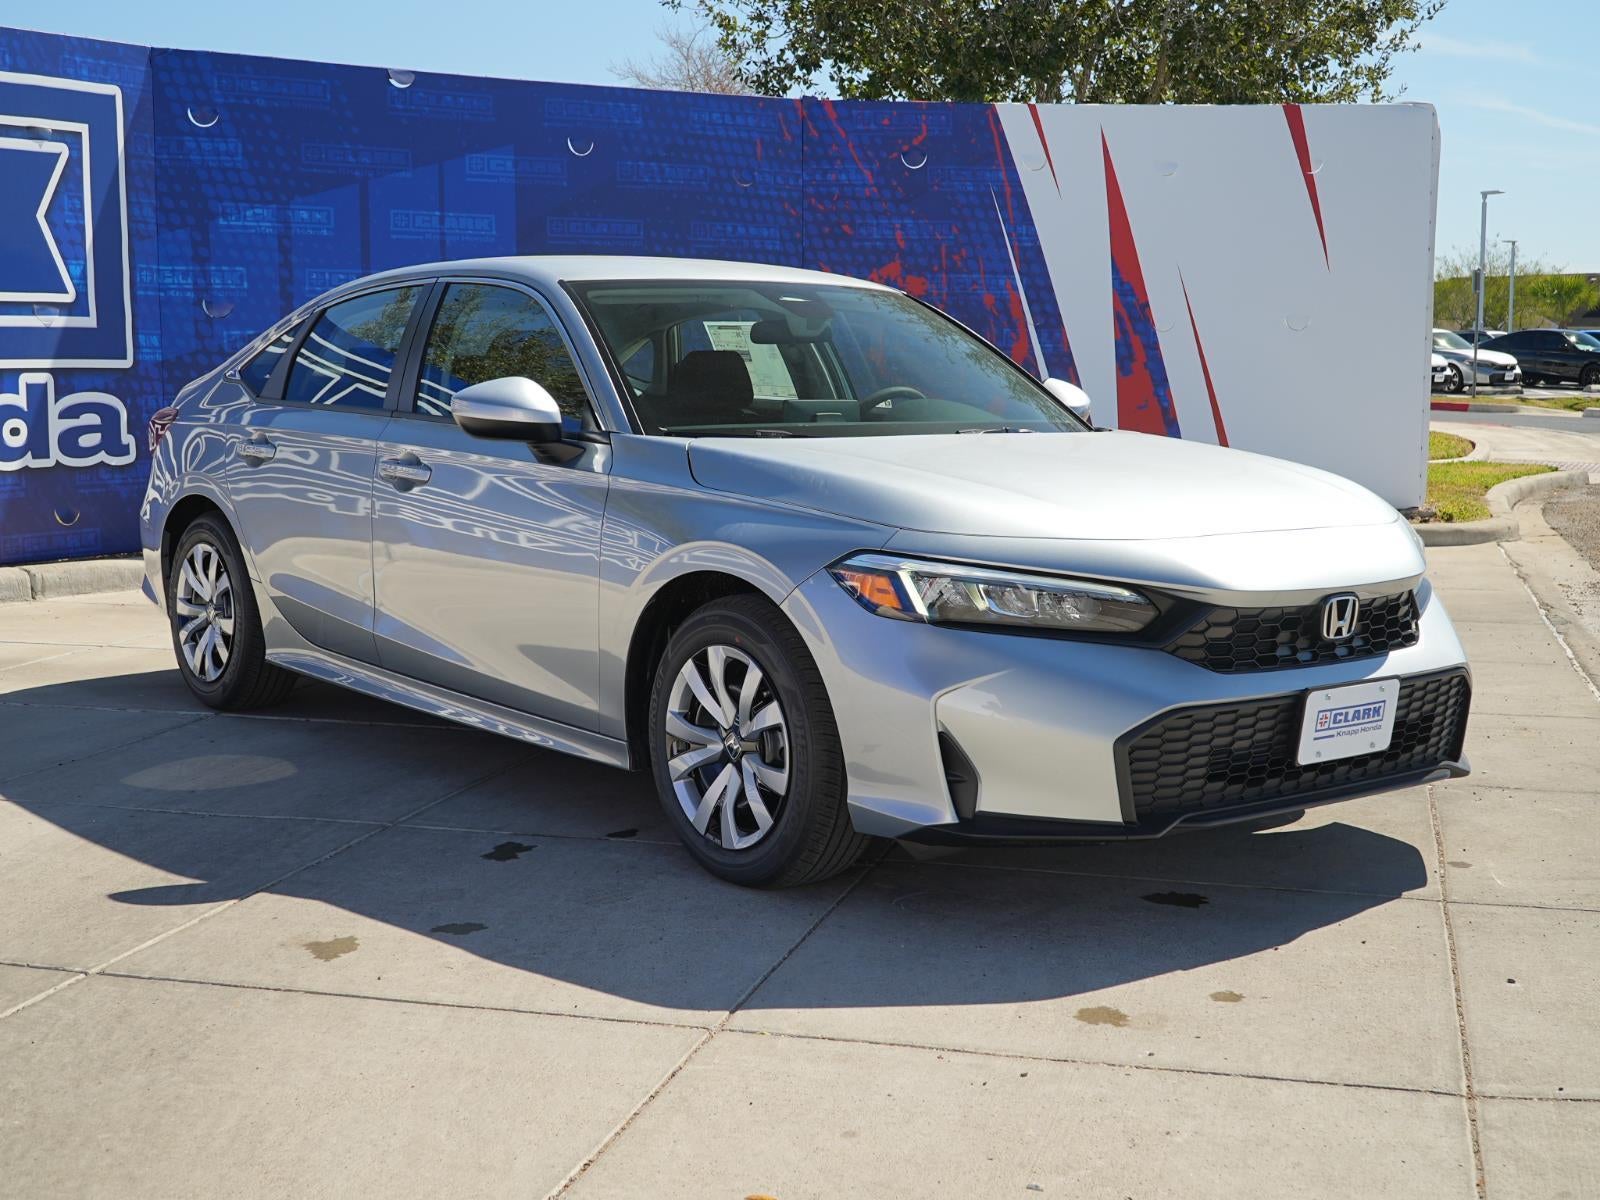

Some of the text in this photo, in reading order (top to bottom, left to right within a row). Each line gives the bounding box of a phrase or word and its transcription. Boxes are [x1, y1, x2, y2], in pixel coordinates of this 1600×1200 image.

[1332, 705, 1382, 725] CLARK
[1336, 724, 1382, 737] Knapp Honda
